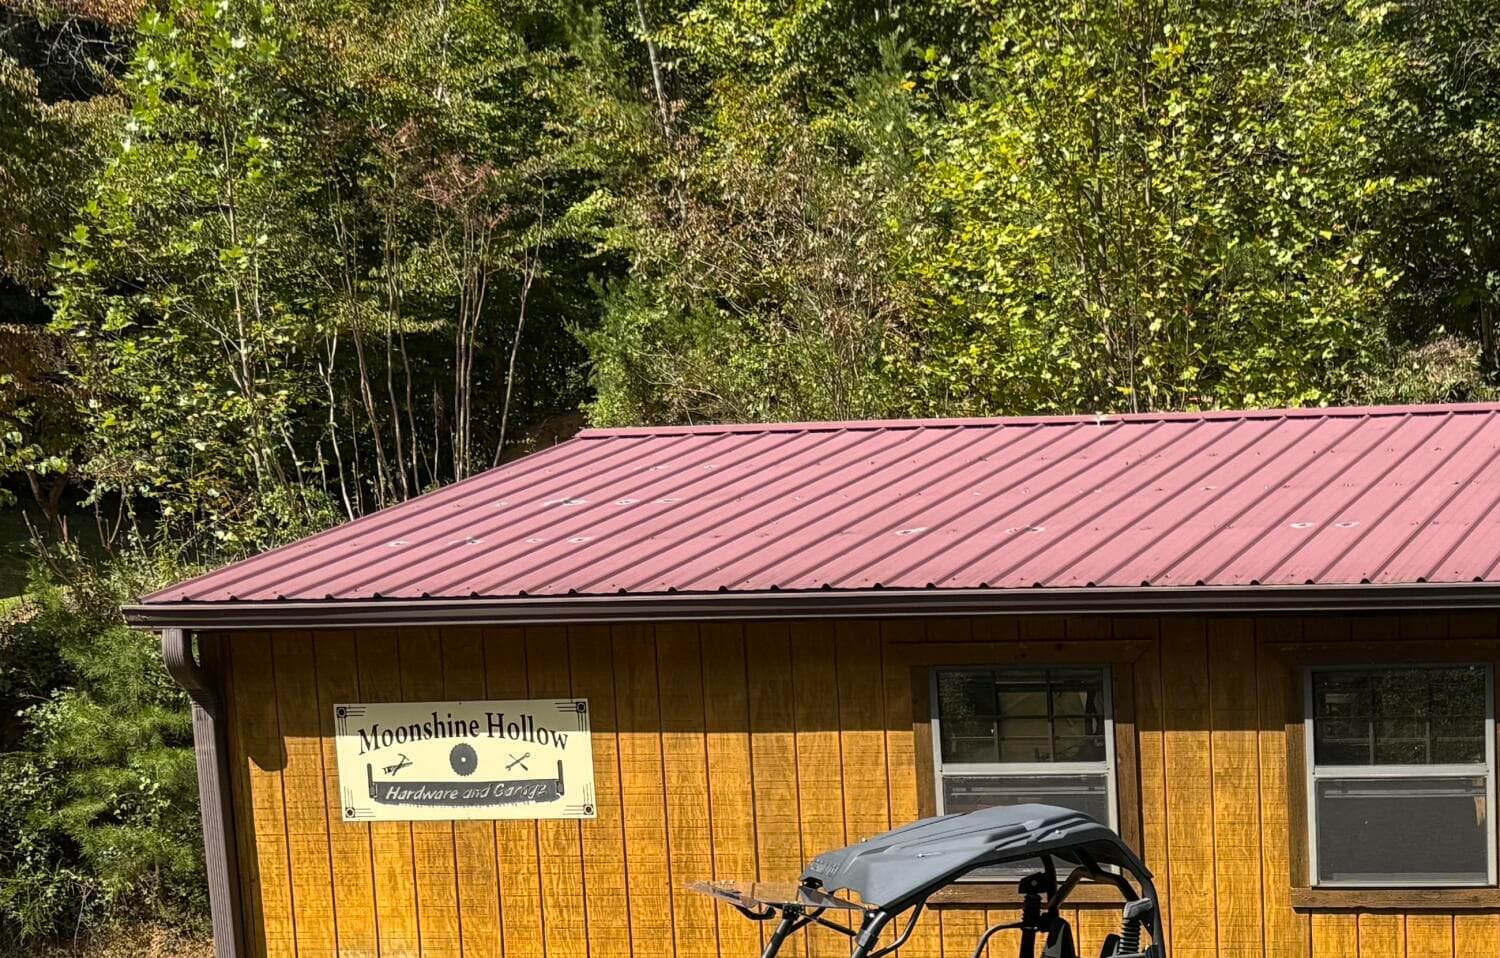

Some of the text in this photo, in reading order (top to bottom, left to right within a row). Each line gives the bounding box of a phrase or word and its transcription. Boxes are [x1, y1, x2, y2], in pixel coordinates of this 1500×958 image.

[358, 712, 569, 755] Moonshine Hollow
[386, 783, 548, 801] Hardware and Garage
